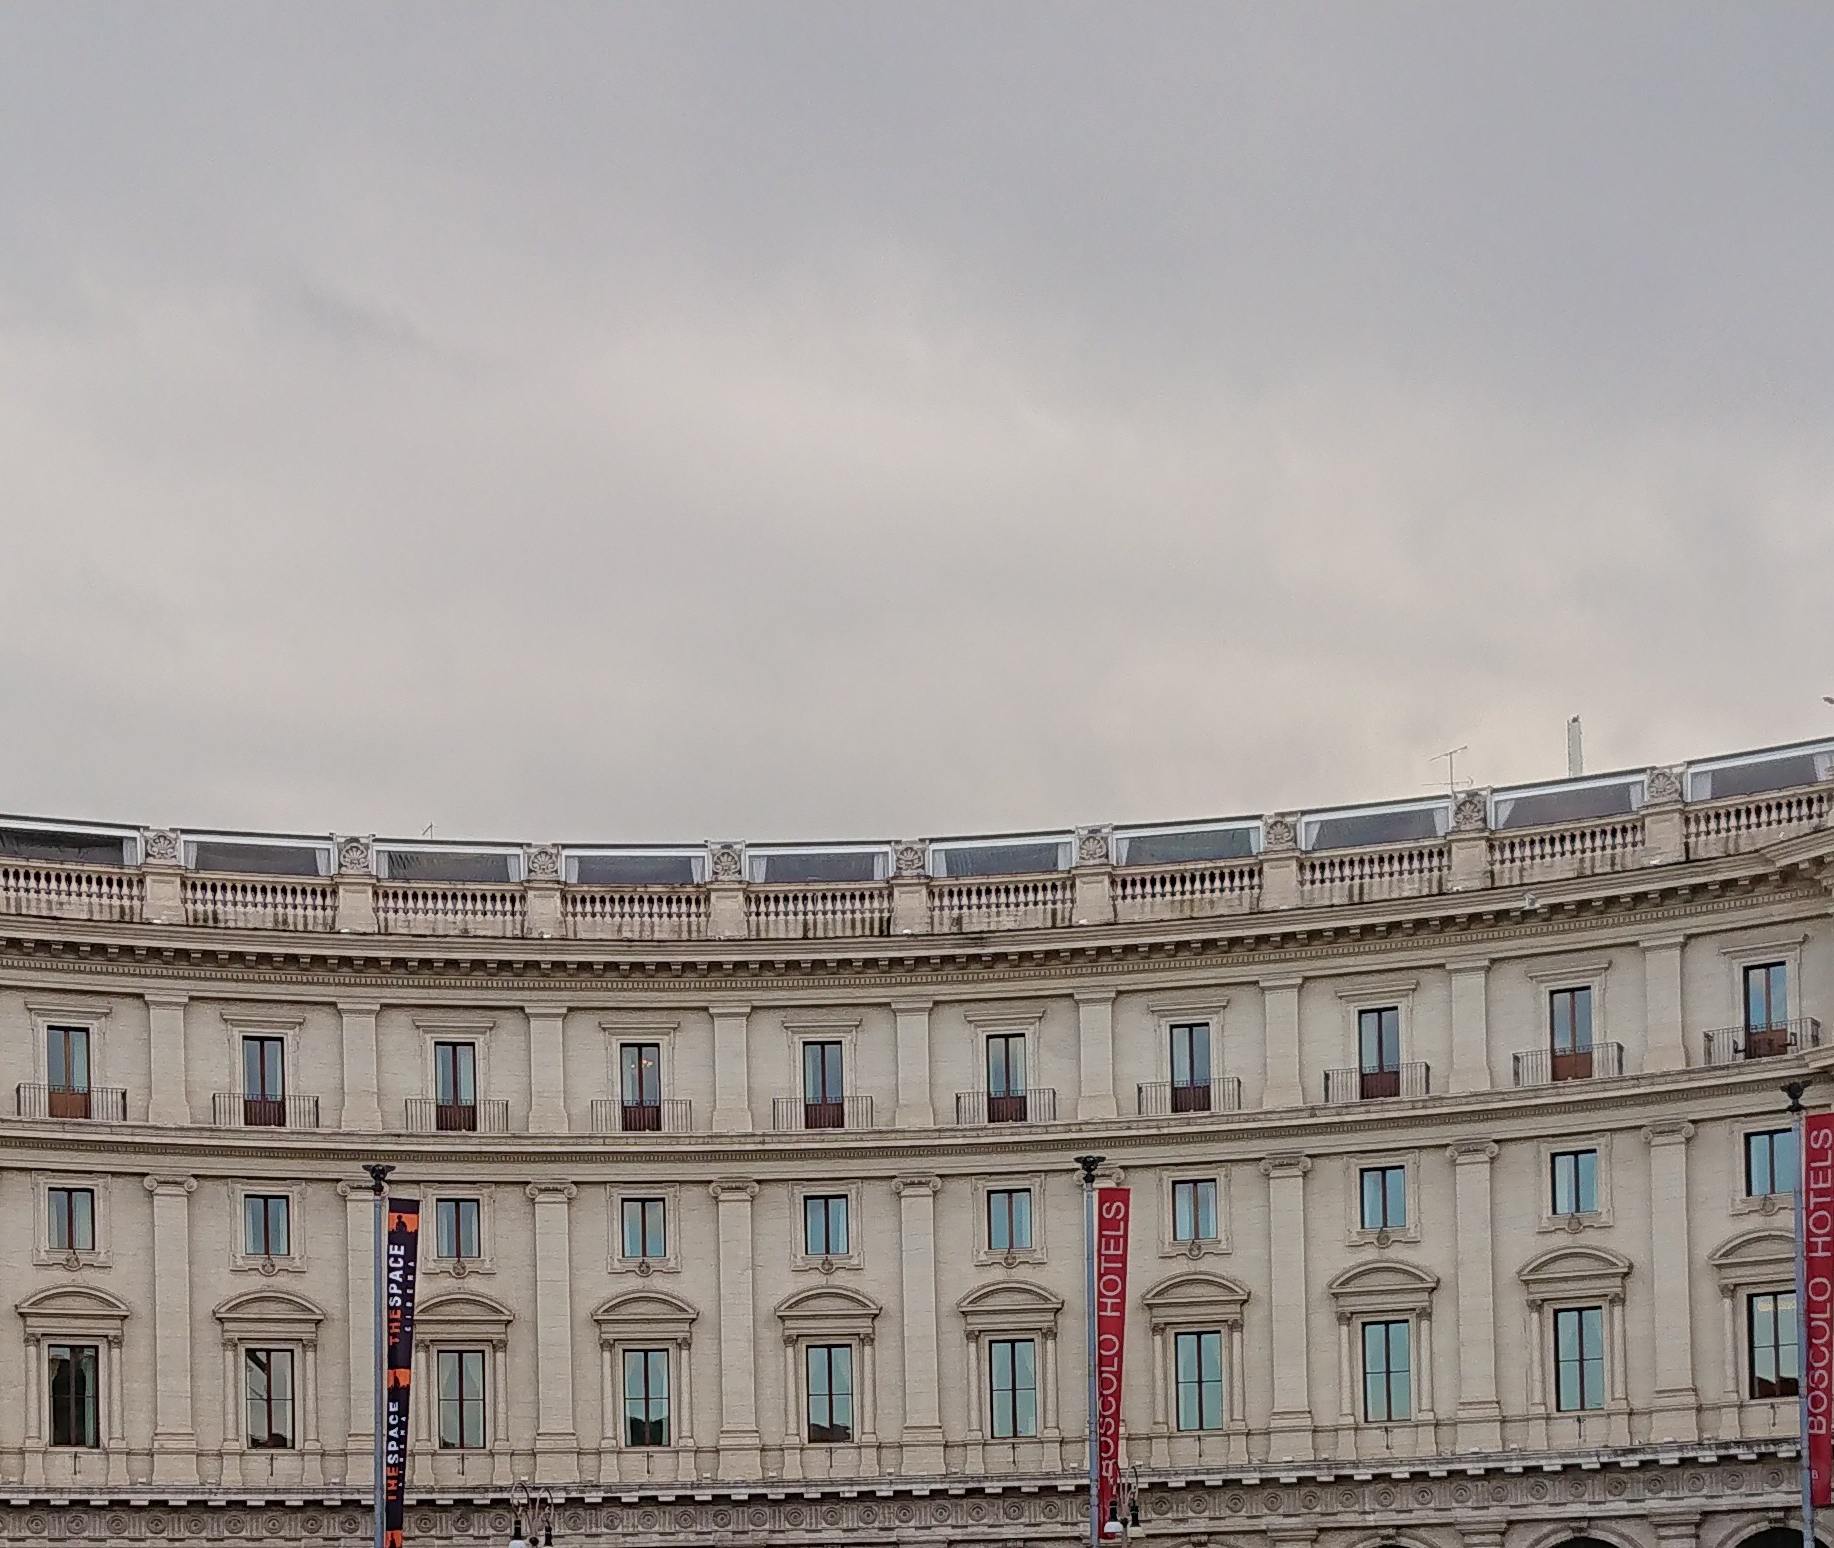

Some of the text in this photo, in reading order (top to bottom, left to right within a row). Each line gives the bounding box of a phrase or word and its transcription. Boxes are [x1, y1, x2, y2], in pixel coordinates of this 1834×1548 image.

[1099, 1201, 1126, 1477] BOSCOLO HOTELS
[1808, 1127, 1834, 1436] BOSCOLO HOTELS
